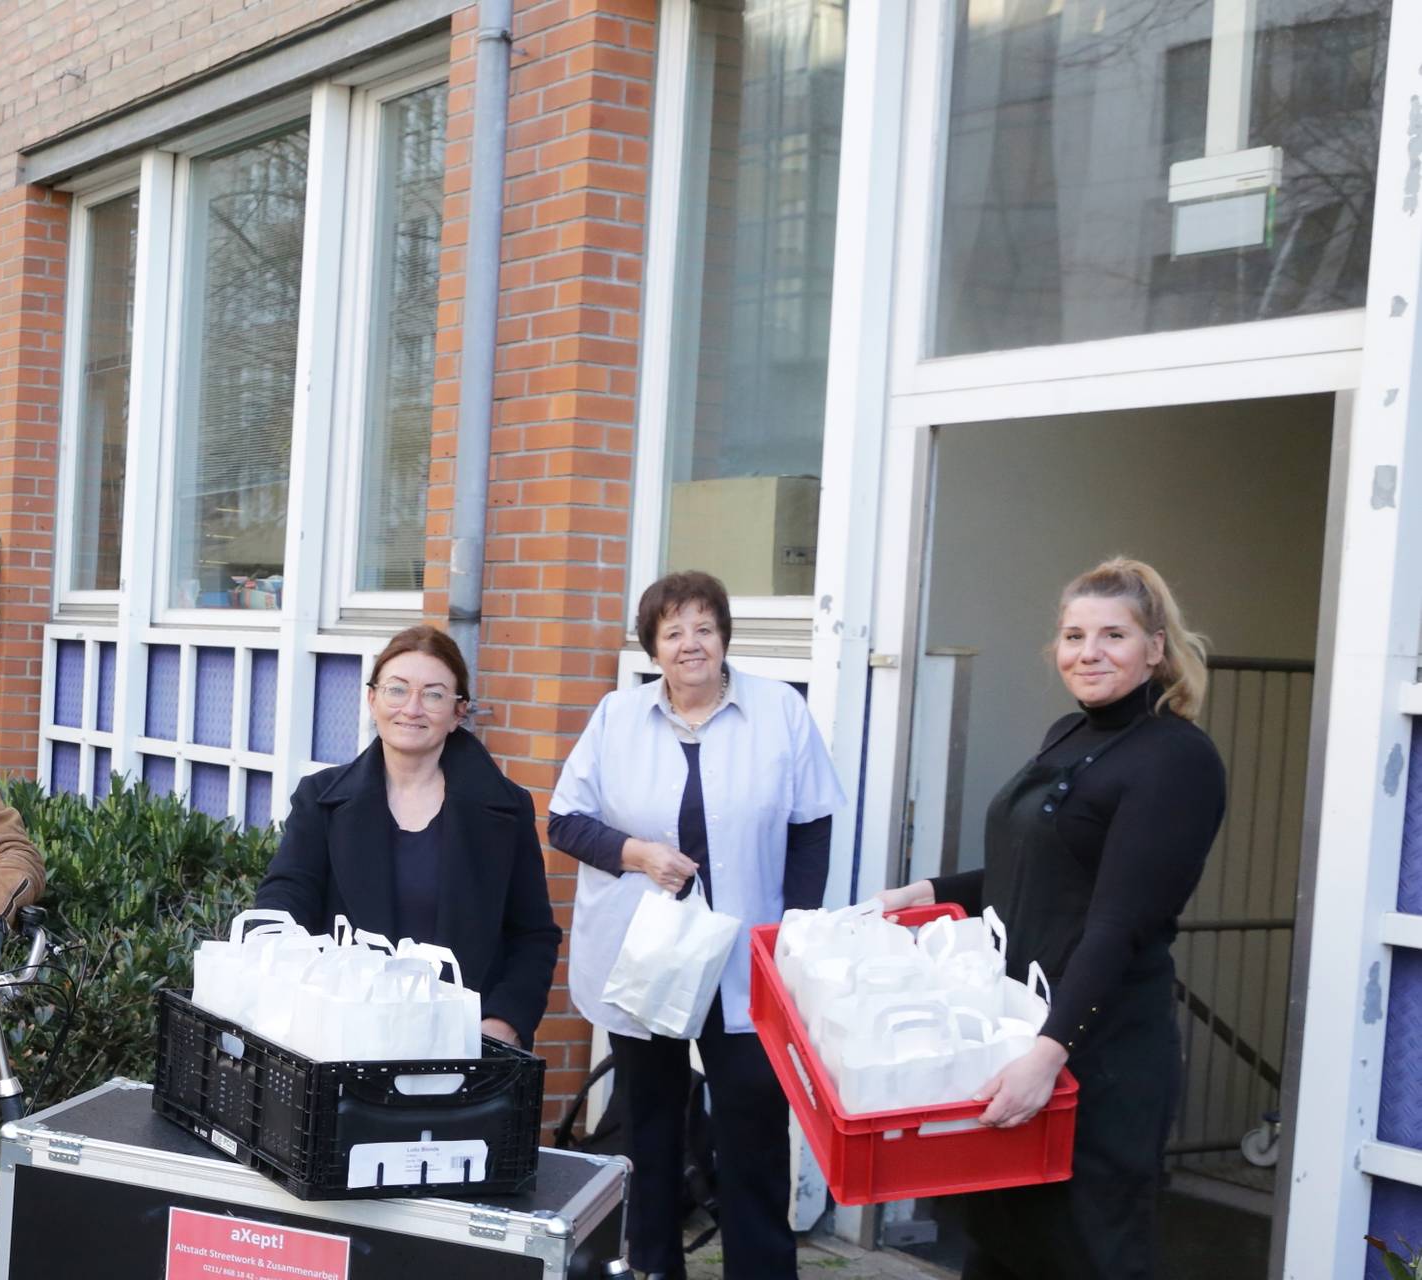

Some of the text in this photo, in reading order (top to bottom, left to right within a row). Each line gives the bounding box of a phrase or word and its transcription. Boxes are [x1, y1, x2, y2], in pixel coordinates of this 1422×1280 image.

[231, 1228, 284, 1249] aXept!
[175, 1243, 339, 1280] Altstadt Streetwork & Zusammenarbeit
